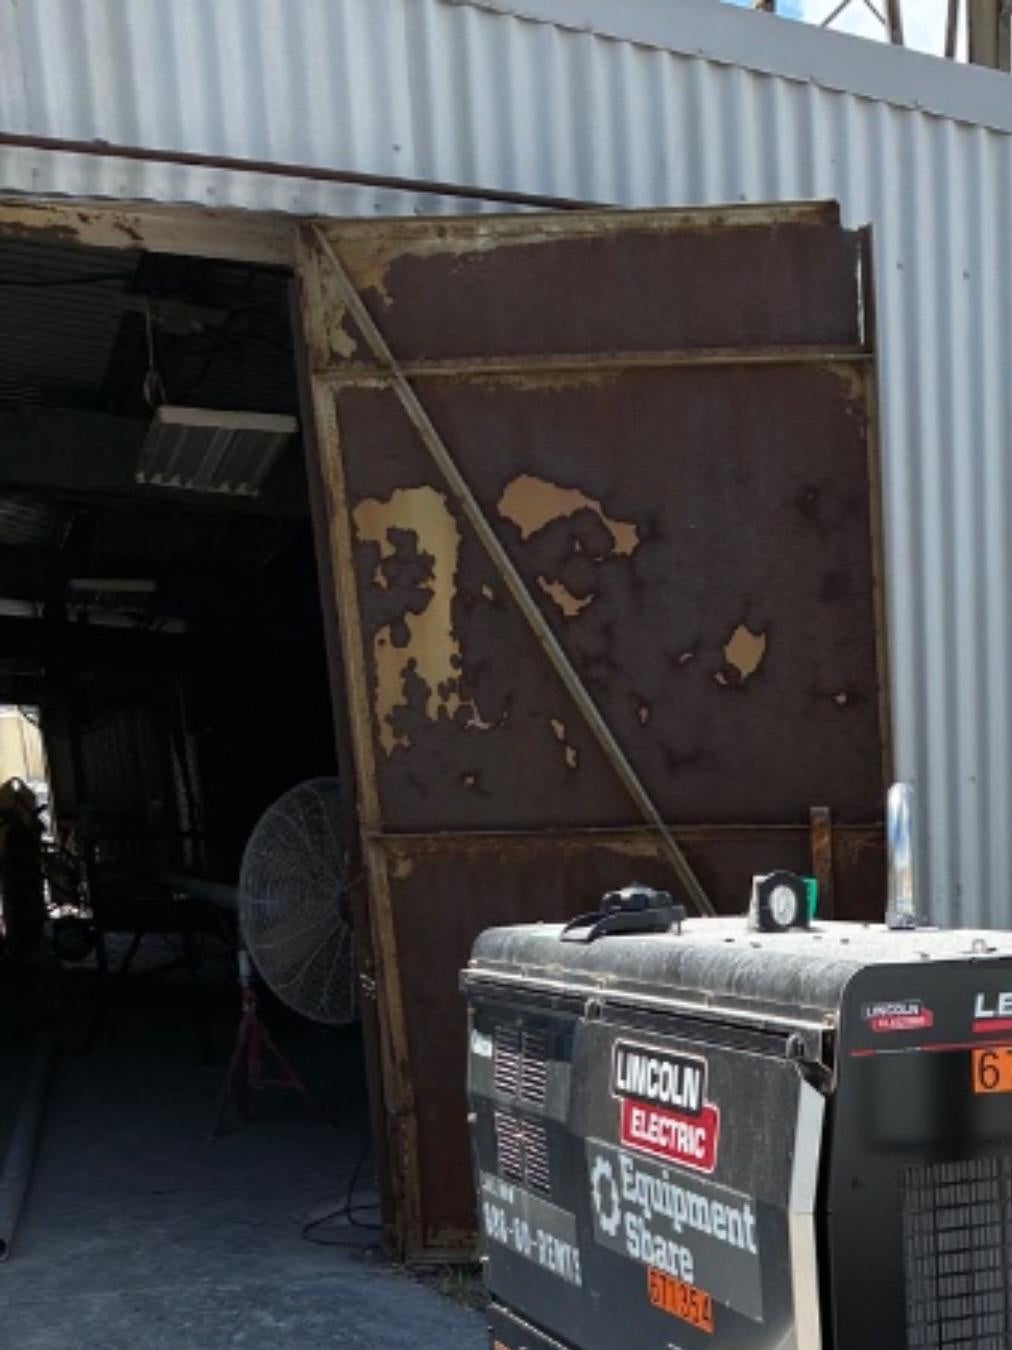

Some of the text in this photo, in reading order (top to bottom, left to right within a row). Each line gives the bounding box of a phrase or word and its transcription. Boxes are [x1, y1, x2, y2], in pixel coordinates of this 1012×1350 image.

[616, 1050, 700, 1112] LINCOLN
[630, 1106, 706, 1159] ELECTRIC
[619, 1154, 758, 1255] Equipment
[624, 1211, 694, 1275] Share
